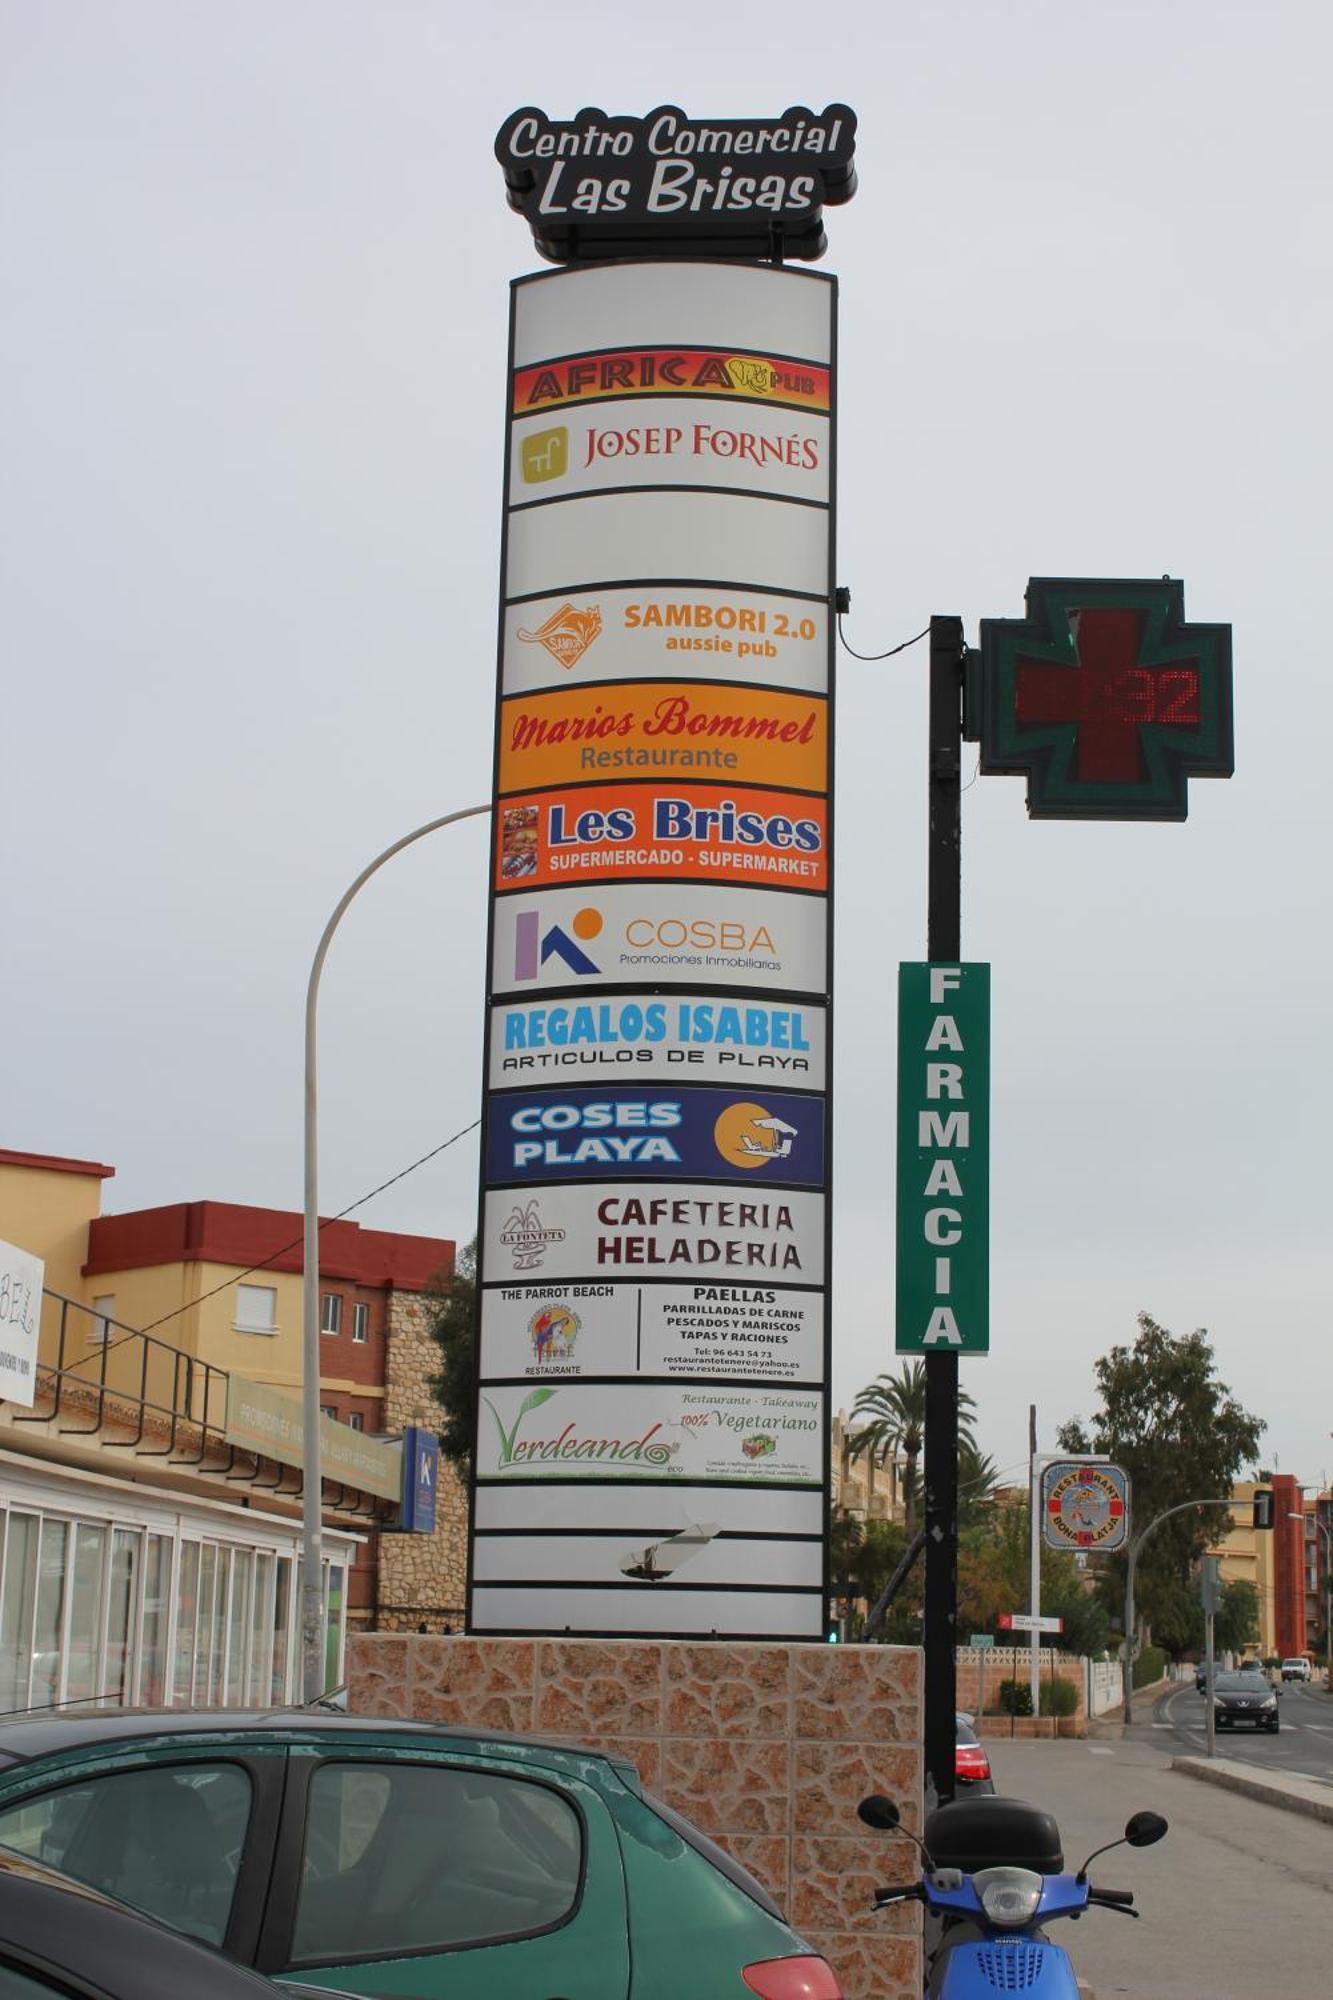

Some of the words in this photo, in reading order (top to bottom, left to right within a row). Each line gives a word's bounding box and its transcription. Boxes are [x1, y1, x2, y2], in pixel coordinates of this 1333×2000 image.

[509, 118, 633, 157] Centro
[648, 115, 842, 155] Comercial
[539, 161, 631, 214] Las
[647, 160, 814, 212] Brisas
[527, 357, 735, 404] AFRICA
[770, 371, 815, 395] PUB
[584, 428, 682, 468] JOSEP
[693, 425, 818, 470] FORNÉS
[624, 604, 765, 633] SAMBORI
[773, 614, 816, 640] 2.0
[666, 635, 733, 653] aussie
[738, 640, 778, 658] pub
[511, 707, 634, 751] Marios
[643, 696, 816, 744] Bommel
[581, 747, 738, 769] Restaurante
[548, 805, 634, 847] Les
[653, 798, 822, 852] Brises
[550, 849, 683, 871] SUPERMERCADO
[699, 851, 818, 877] SUPERMARKET
[626, 919, 776, 954] COSBA
[620, 953, 702, 966] Promociones
[705, 955, 782, 971] Inmobiliarias
[505, 1004, 667, 1050] REGALOS
[678, 1004, 810, 1051] ISABEL
[503, 1050, 653, 1071] ARTICULOS
[667, 1050, 705, 1063] DE
[719, 1051, 809, 1071] PLAYA
[510, 1101, 683, 1133] COSES
[512, 1136, 683, 1168] PLAYA
[918, 968, 969, 1343] FARMACIA
[597, 1198, 795, 1232] CAFETERIA
[597, 1237, 802, 1270] HELADERIA
[501, 1290, 522, 1301] THE
[525, 1287, 570, 1300] PARROT
[573, 1286, 614, 1298] BEACH
[694, 1287, 776, 1303] PAELLAS
[663, 1304, 746, 1316] PARRILLADAS
[749, 1308, 764, 1317] DE
[767, 1309, 805, 1320] CARNE
[667, 1317, 729, 1328] PESCADOS
[732, 1320, 740, 1328] Y
[742, 1321, 801, 1332] MARISCOS
[680, 1331, 718, 1341] TAPAS
[720, 1332, 729, 1341] Y
[731, 1333, 788, 1344] RACIONES
[525, 1366, 581, 1376] RESTAURANTE
[681, 1413, 709, 1427] 100%
[712, 1410, 817, 1432] Vegetariano
